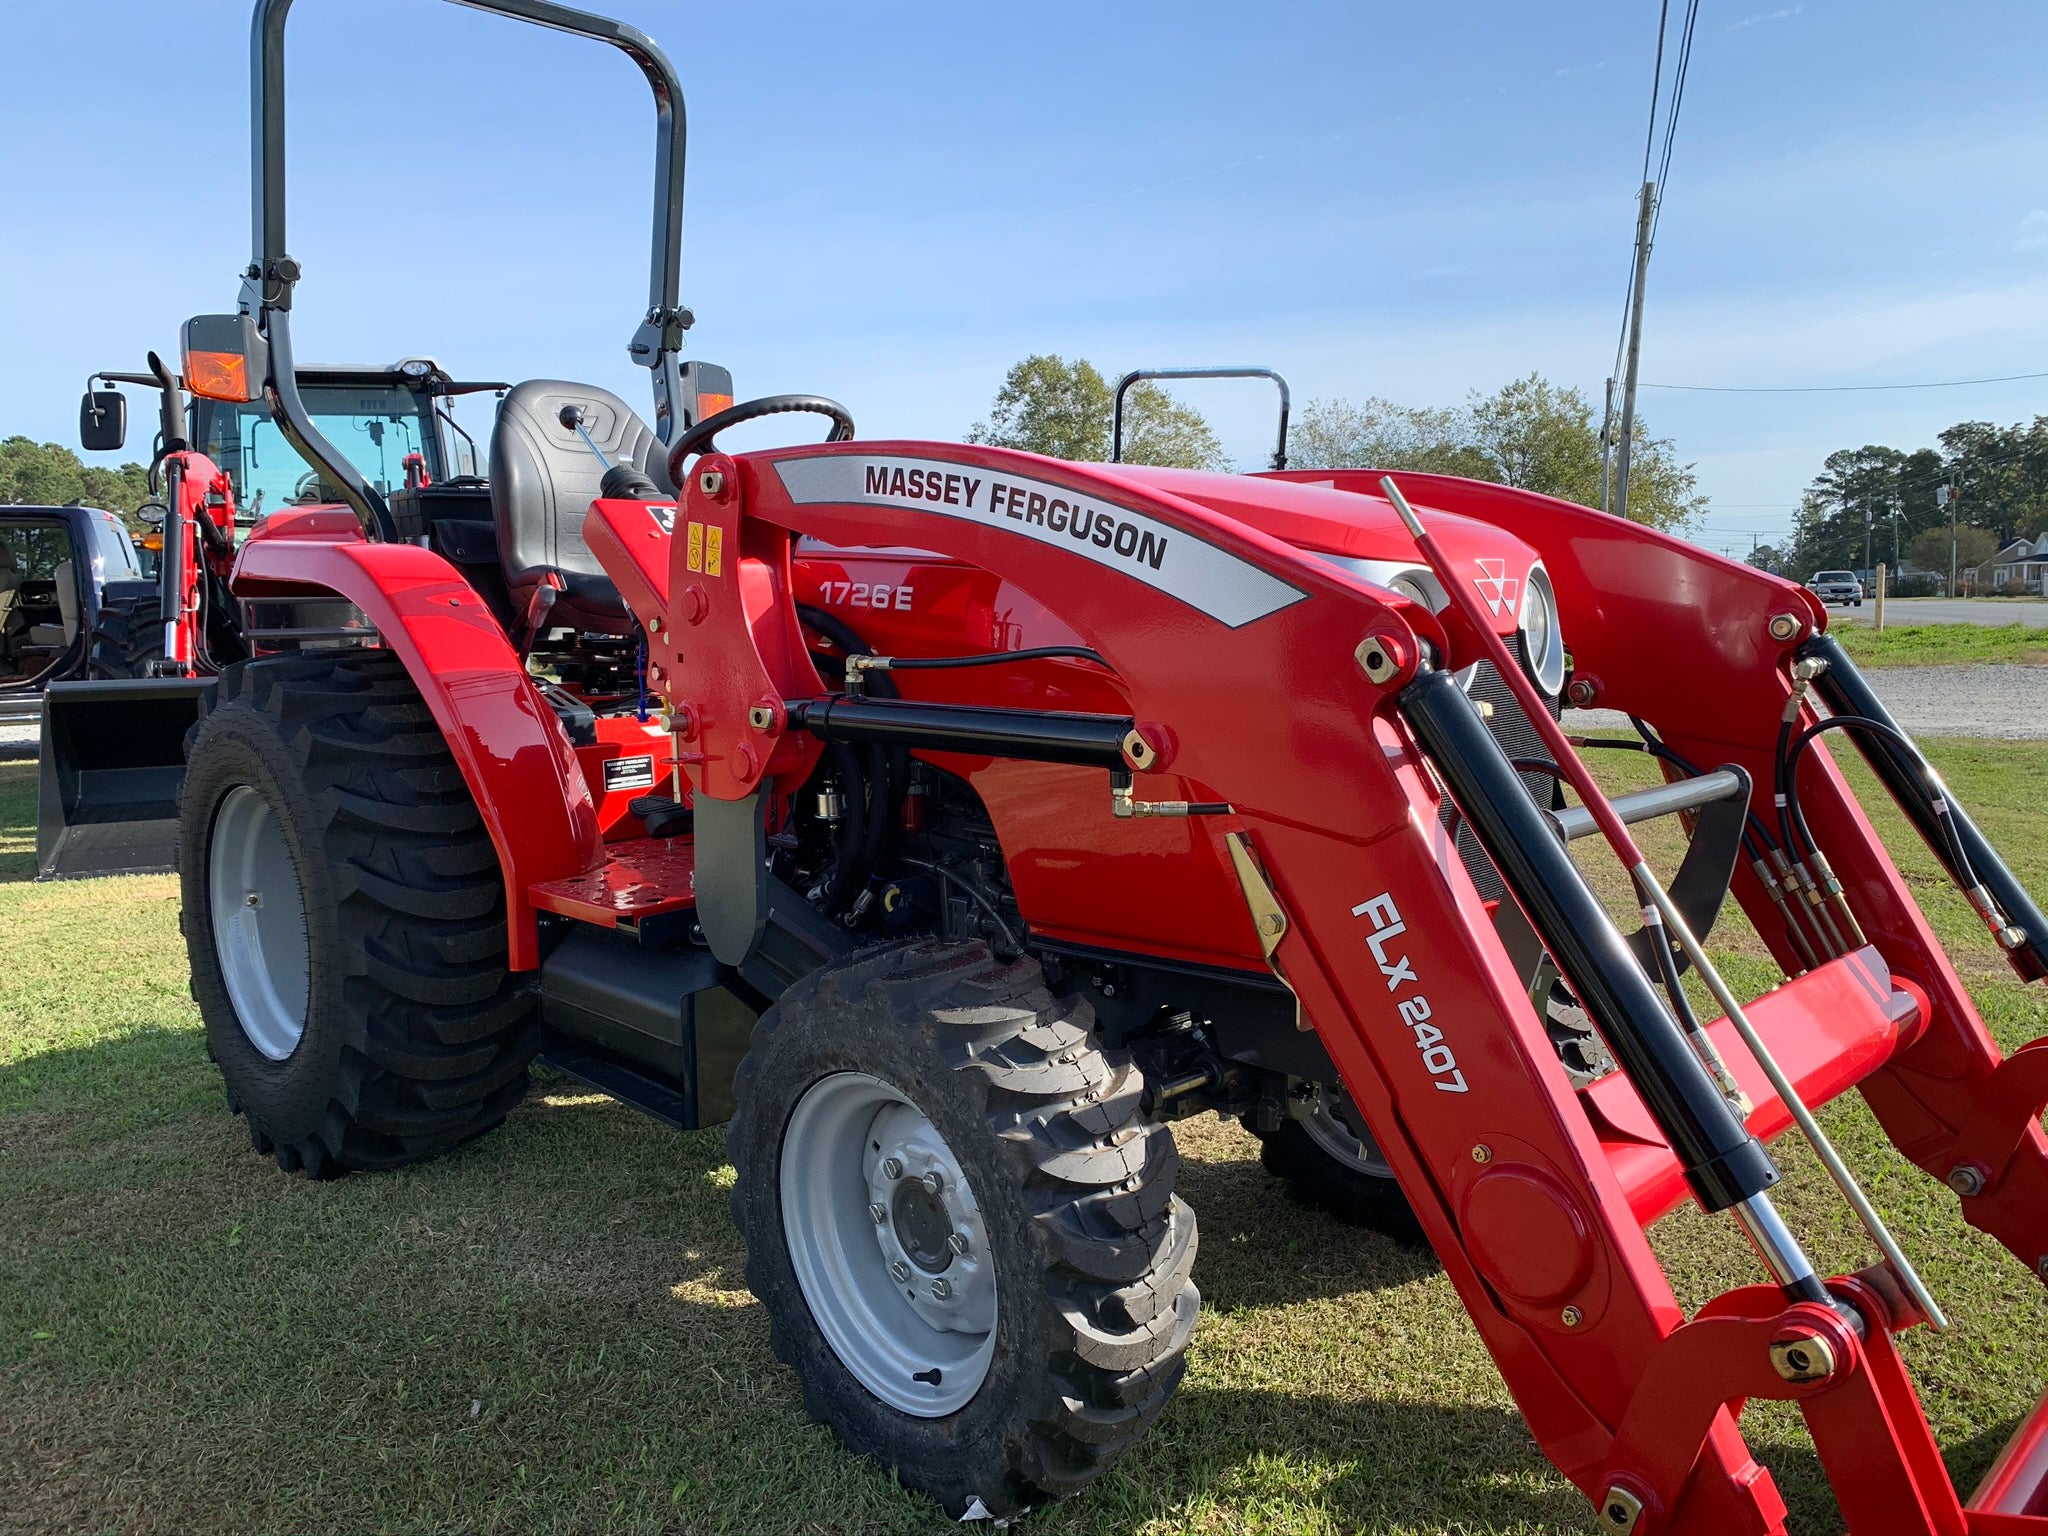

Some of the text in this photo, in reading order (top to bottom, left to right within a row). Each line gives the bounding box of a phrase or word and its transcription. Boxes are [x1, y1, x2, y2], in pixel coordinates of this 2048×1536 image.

[865, 465, 1168, 571] MASSEY FERGUSON
[1397, 995, 1470, 1094] 2407
